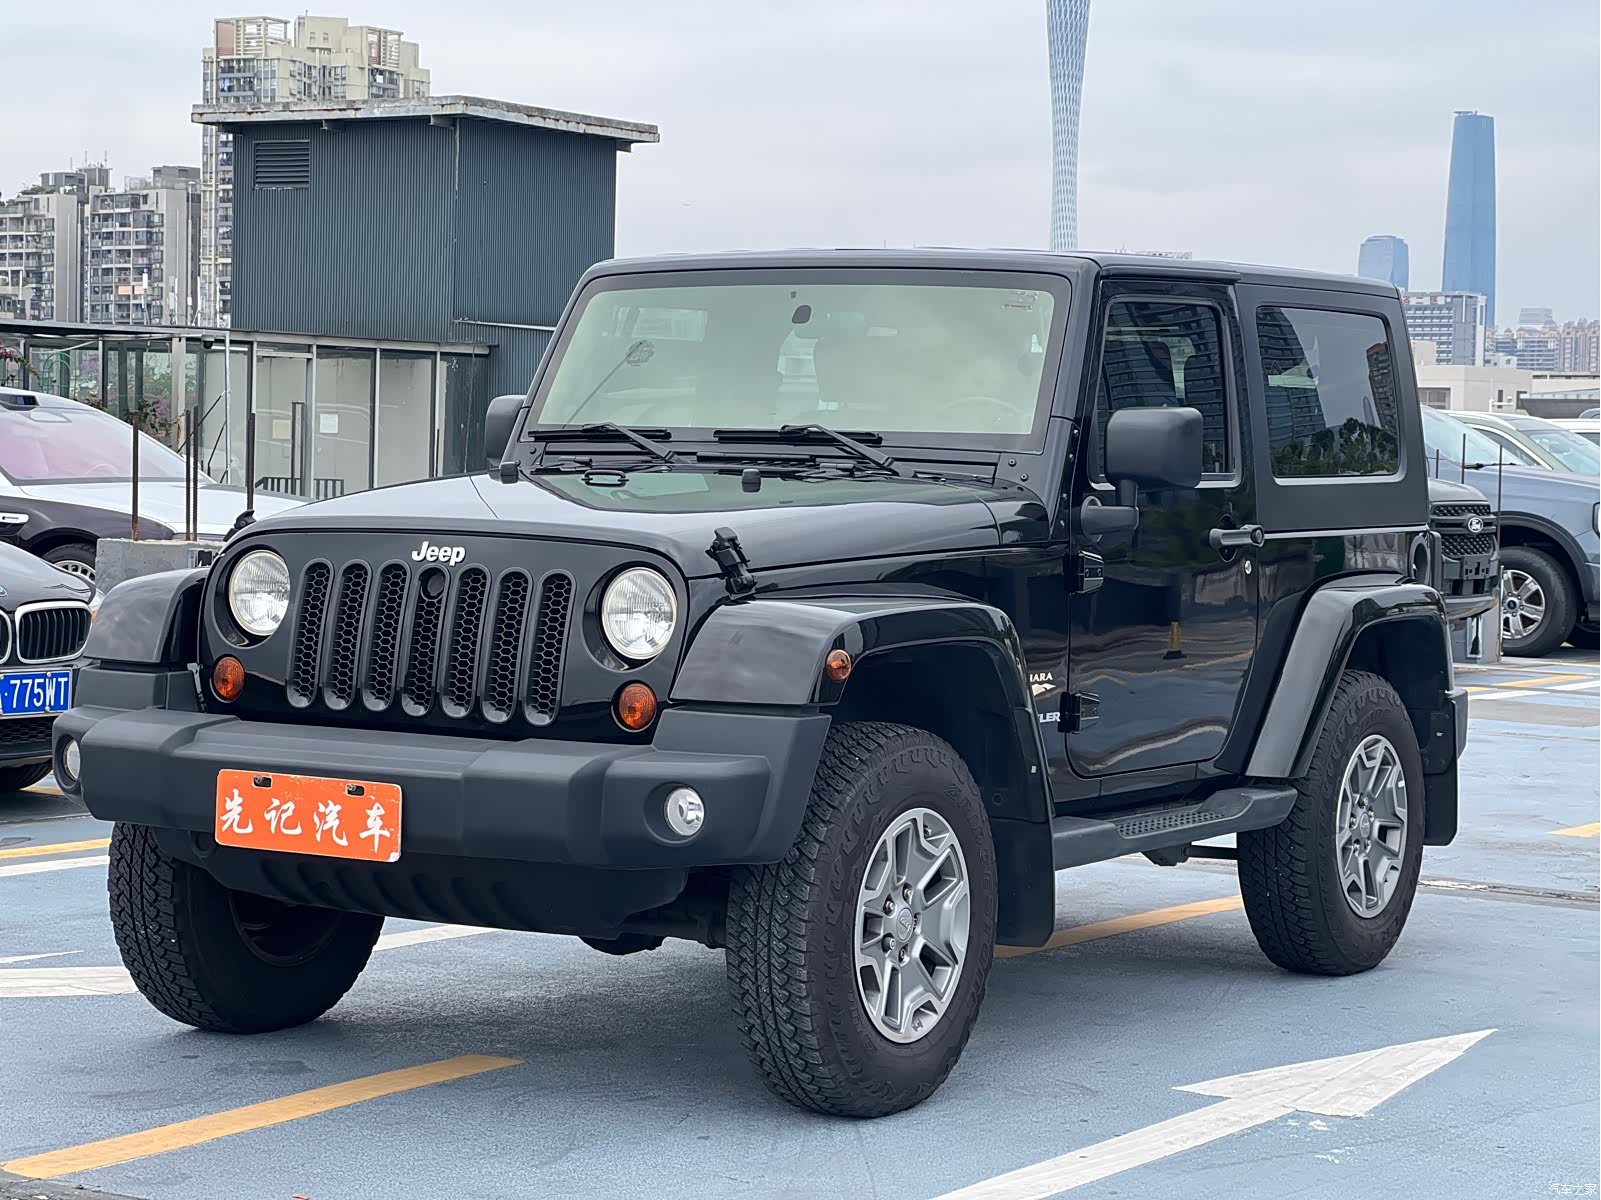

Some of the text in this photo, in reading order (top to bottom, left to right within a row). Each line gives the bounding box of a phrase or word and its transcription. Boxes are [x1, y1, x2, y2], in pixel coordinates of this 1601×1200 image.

[411, 540, 466, 567] Jeep
[1037, 711, 1061, 723] LER
[219, 788, 391, 854] 先记汽车
